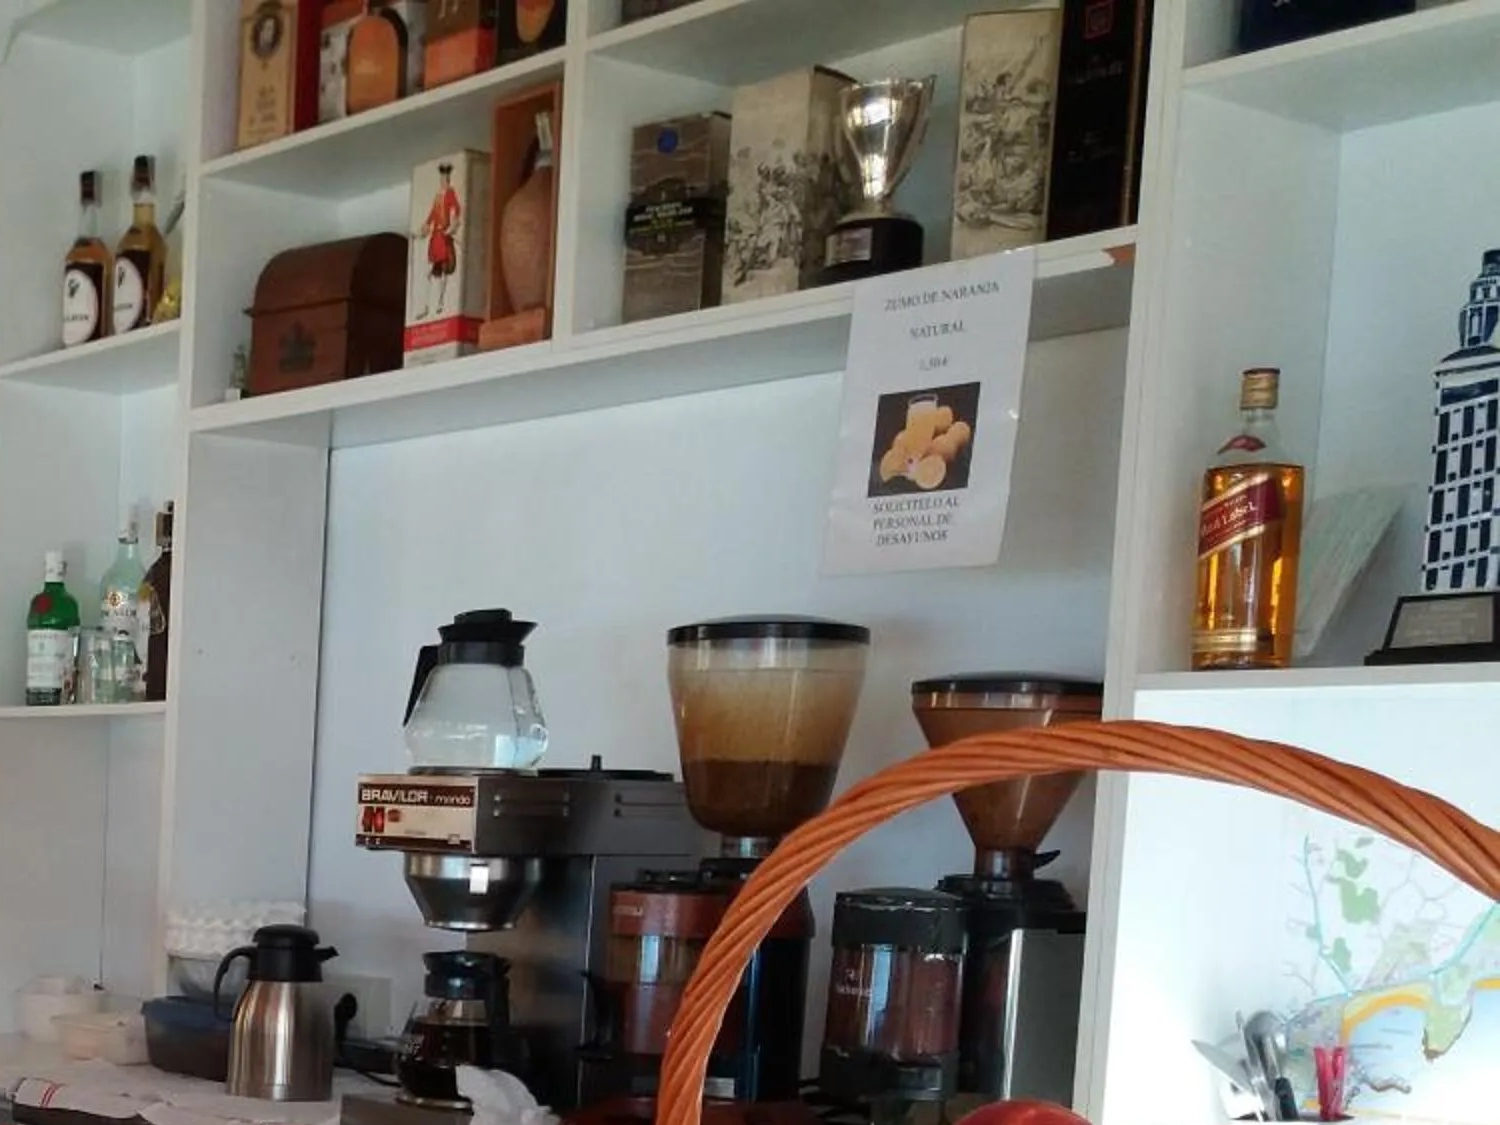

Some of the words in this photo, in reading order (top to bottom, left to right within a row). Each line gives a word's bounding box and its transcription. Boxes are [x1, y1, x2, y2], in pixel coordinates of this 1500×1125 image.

[884, 295, 921, 312] ZUMO
[922, 290, 939, 305] DE
[941, 280, 1000, 300] NARANJA
[909, 321, 965, 339] NATURAL
[873, 514, 935, 530] PERSONAL
[876, 529, 949, 546] DESAYUNOS
[361, 789, 428, 803] BRAVILOR
